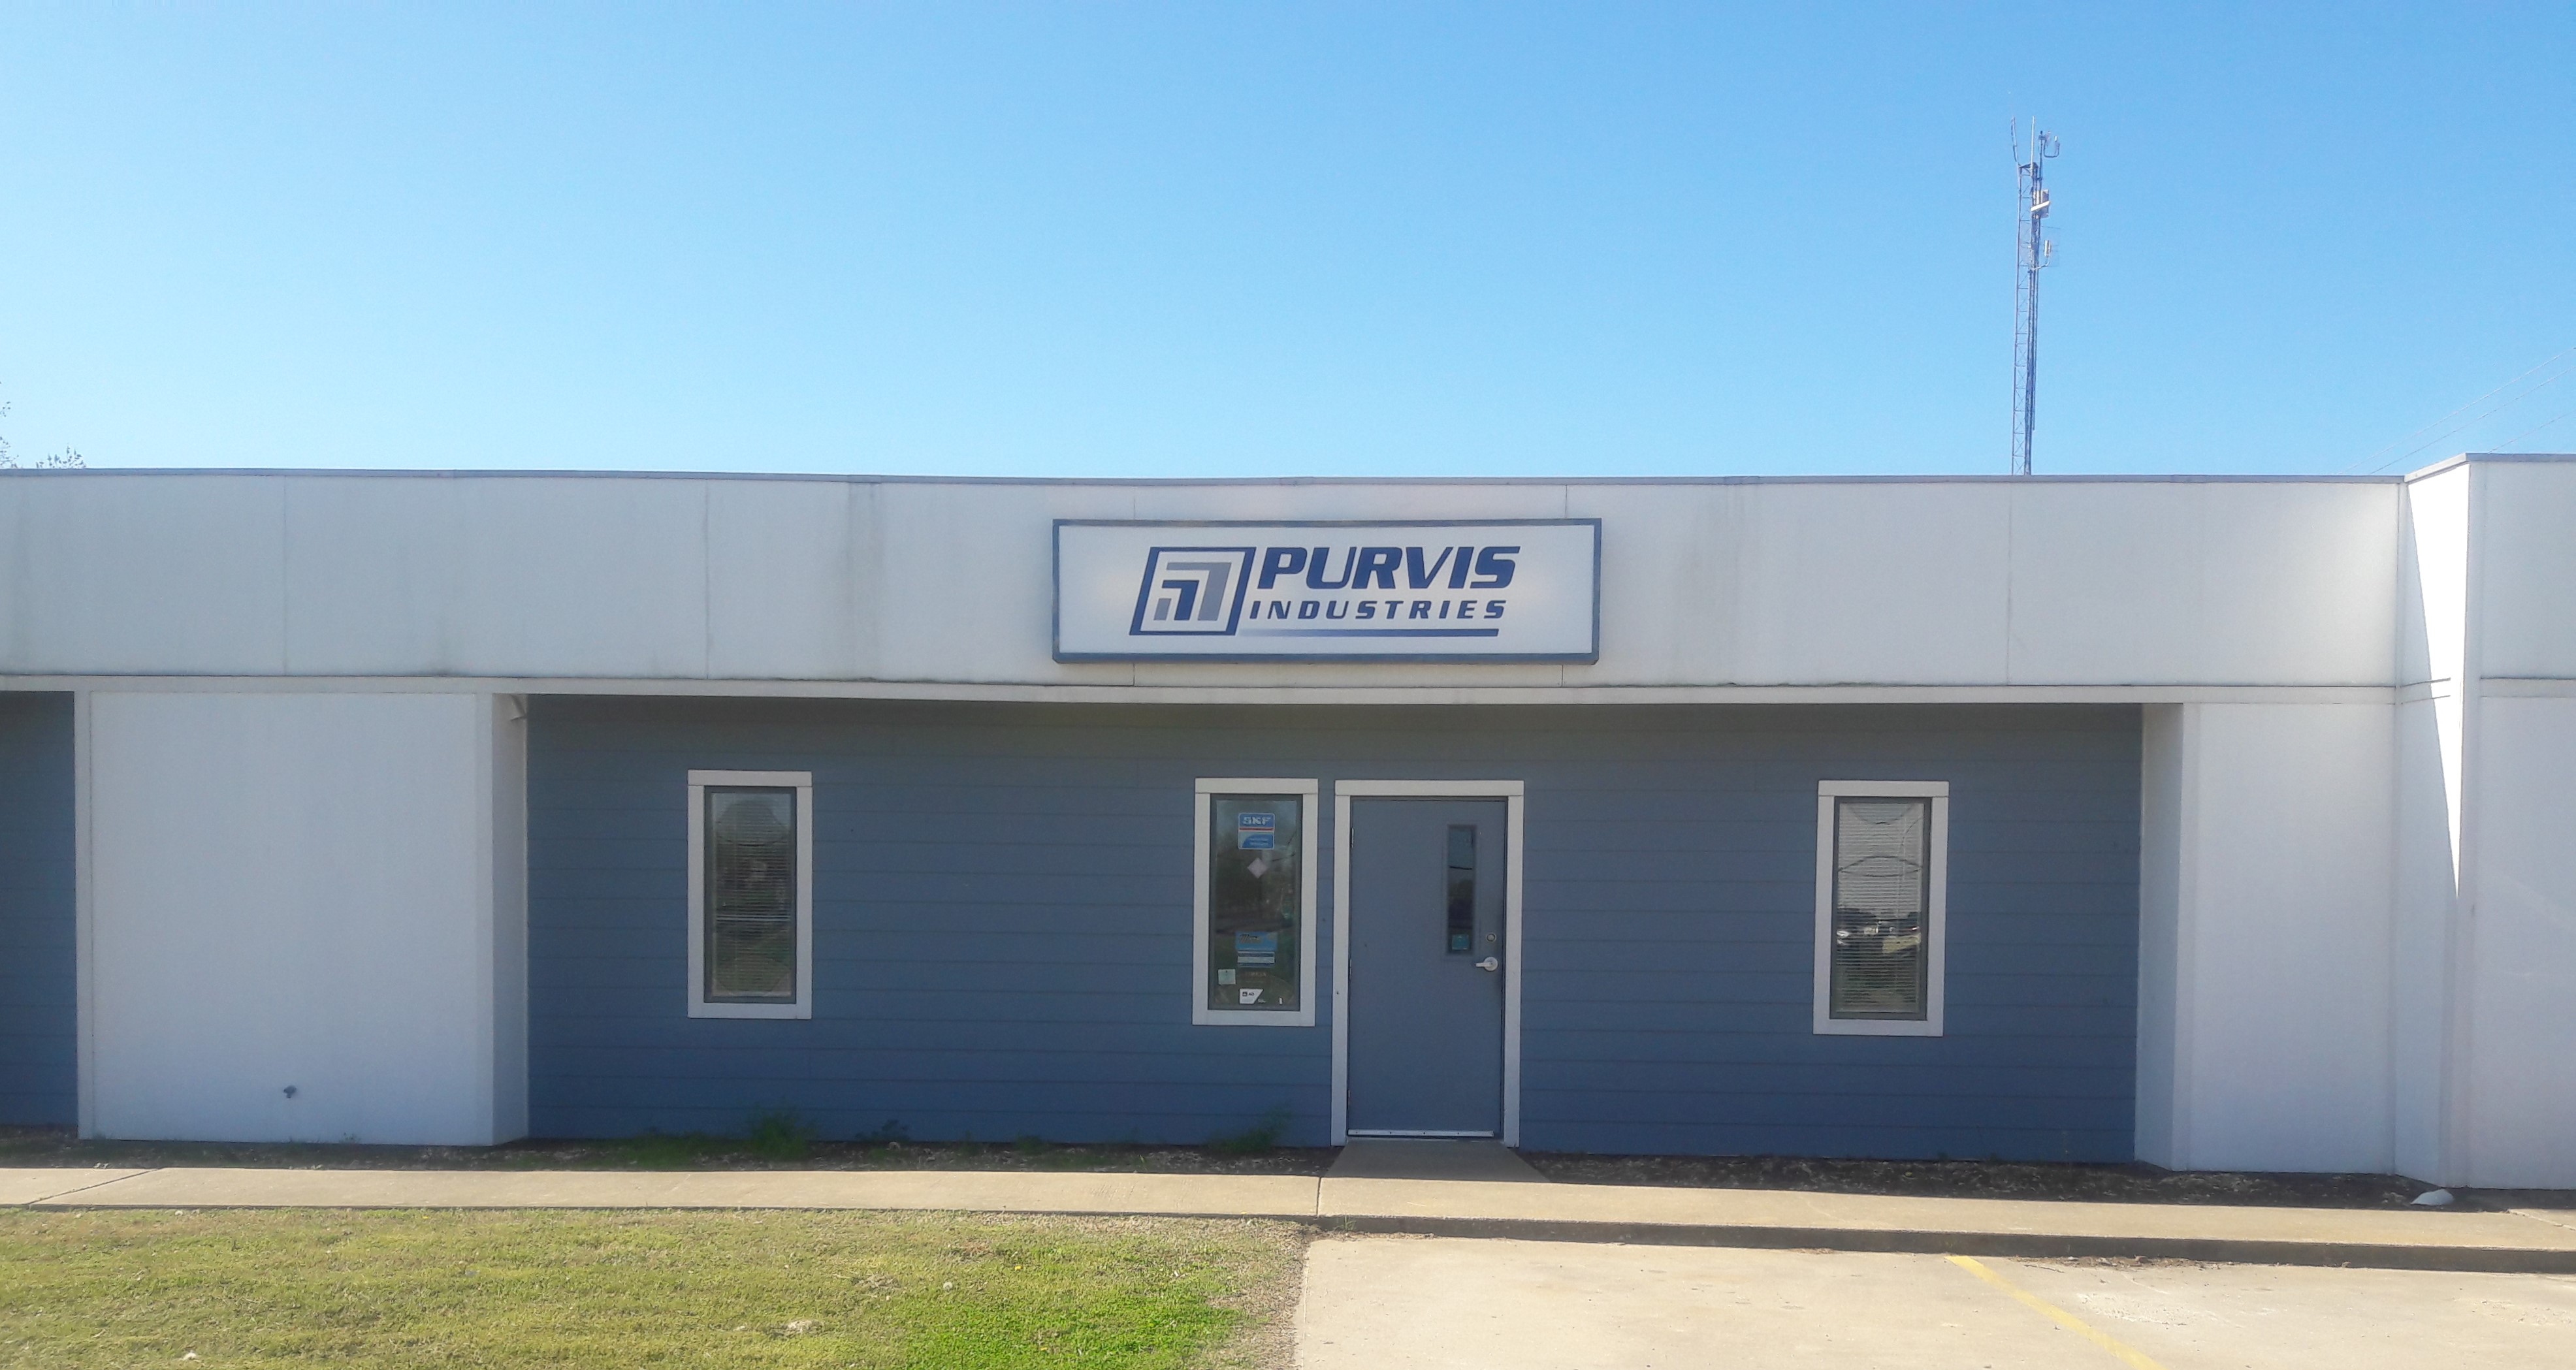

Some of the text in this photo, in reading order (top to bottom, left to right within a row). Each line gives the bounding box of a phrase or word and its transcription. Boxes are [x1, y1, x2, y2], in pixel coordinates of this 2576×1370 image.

[1257, 546, 1521, 590] PURVIS
[1249, 599, 1507, 620] INDUSTRIES
[1243, 816, 1271, 825] SKF
